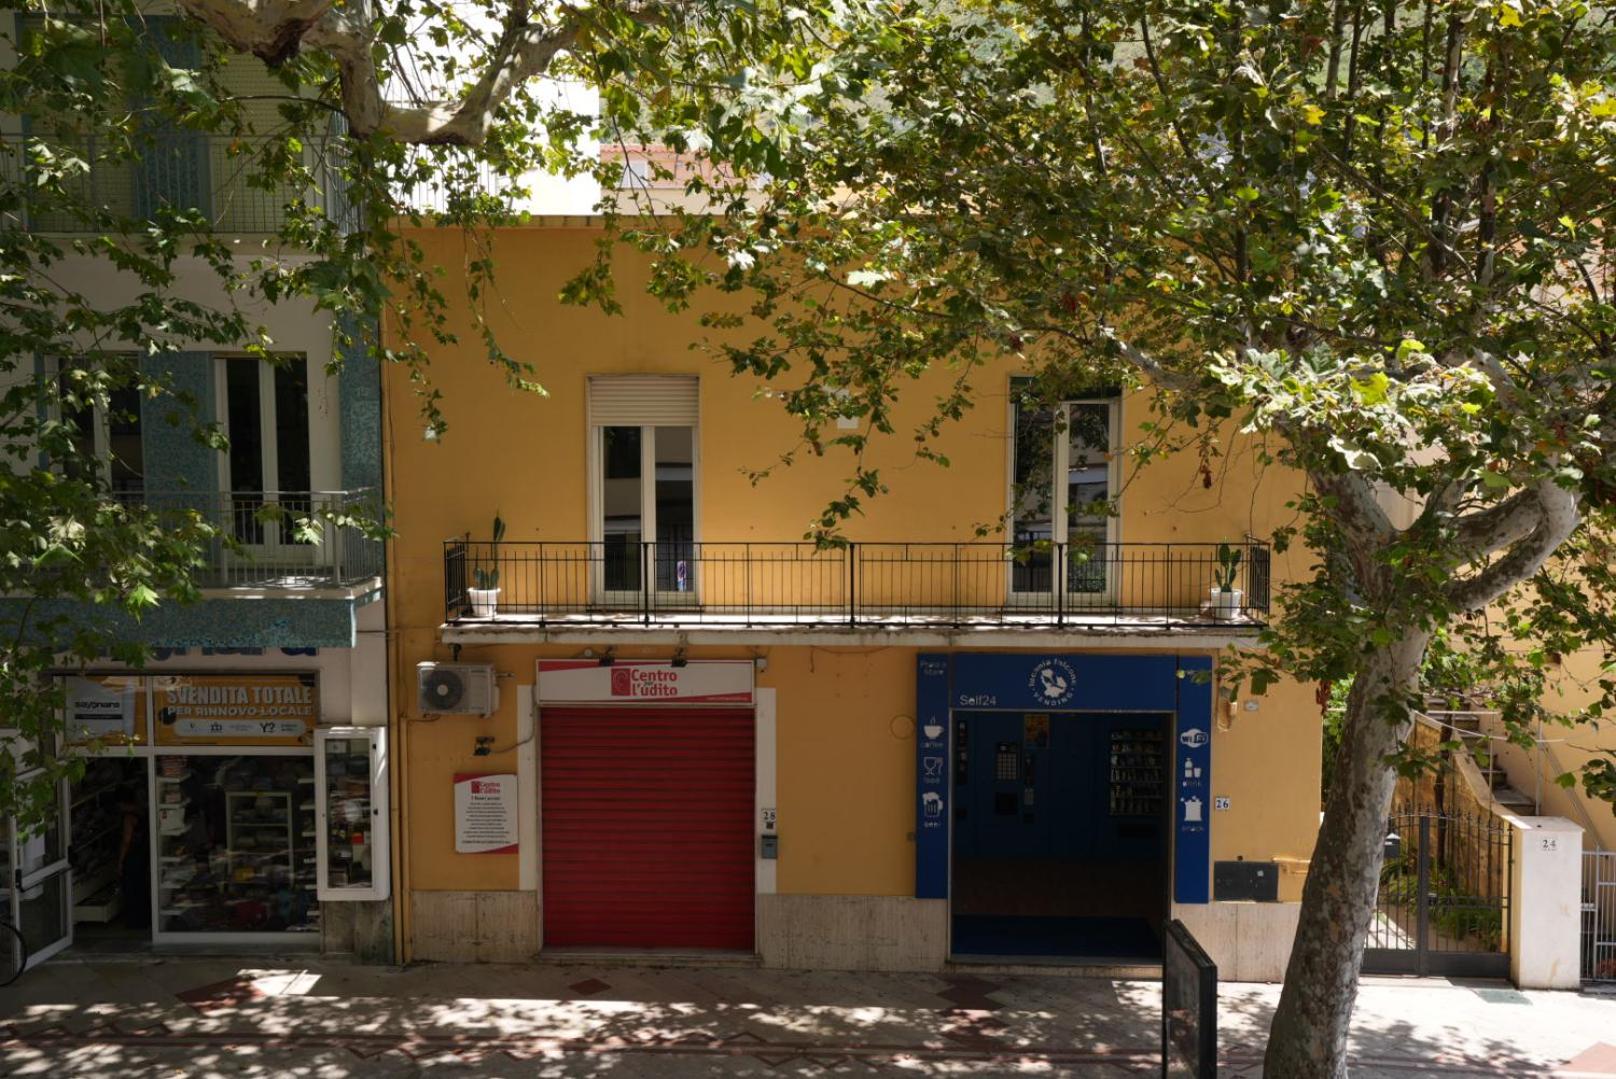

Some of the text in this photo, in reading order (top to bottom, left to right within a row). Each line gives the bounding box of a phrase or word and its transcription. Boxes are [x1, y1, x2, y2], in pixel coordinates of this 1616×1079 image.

[631, 669, 678, 682] Centro
[167, 686, 312, 705] SVENDITA TOTALE
[632, 683, 678, 696] l'udito
[960, 694, 997, 706] Self24
[167, 706, 312, 717] PER RINNOVO LOCALE
[1216, 800, 1229, 809] 26
